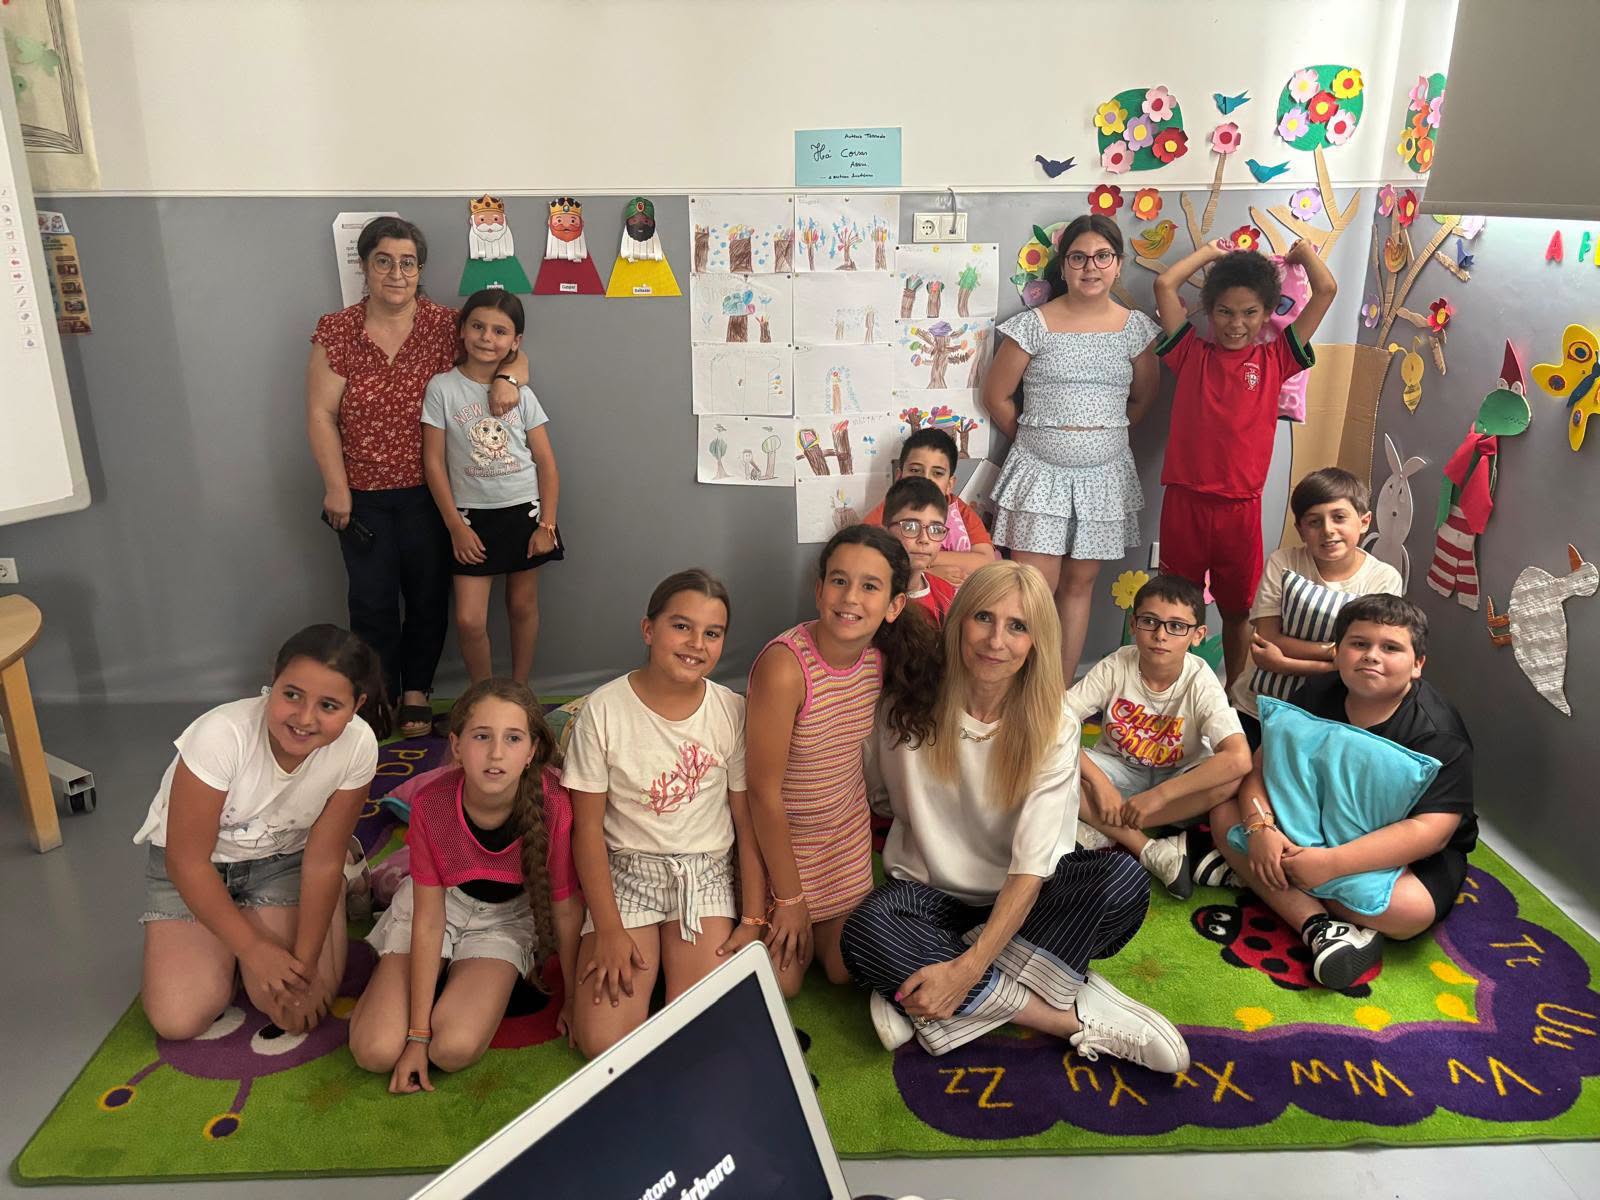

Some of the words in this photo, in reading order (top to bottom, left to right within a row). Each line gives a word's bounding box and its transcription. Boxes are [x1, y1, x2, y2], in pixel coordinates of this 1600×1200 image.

[453, 402, 483, 426] NEW
[1111, 698, 1185, 743] Chupa
[1490, 934, 1545, 968] Tt
[1533, 1002, 1598, 1050] Uu
[938, 1066, 1014, 1108] Zz
[1290, 1058, 1415, 1098] Ww
[1447, 1055, 1544, 1097] Vv
